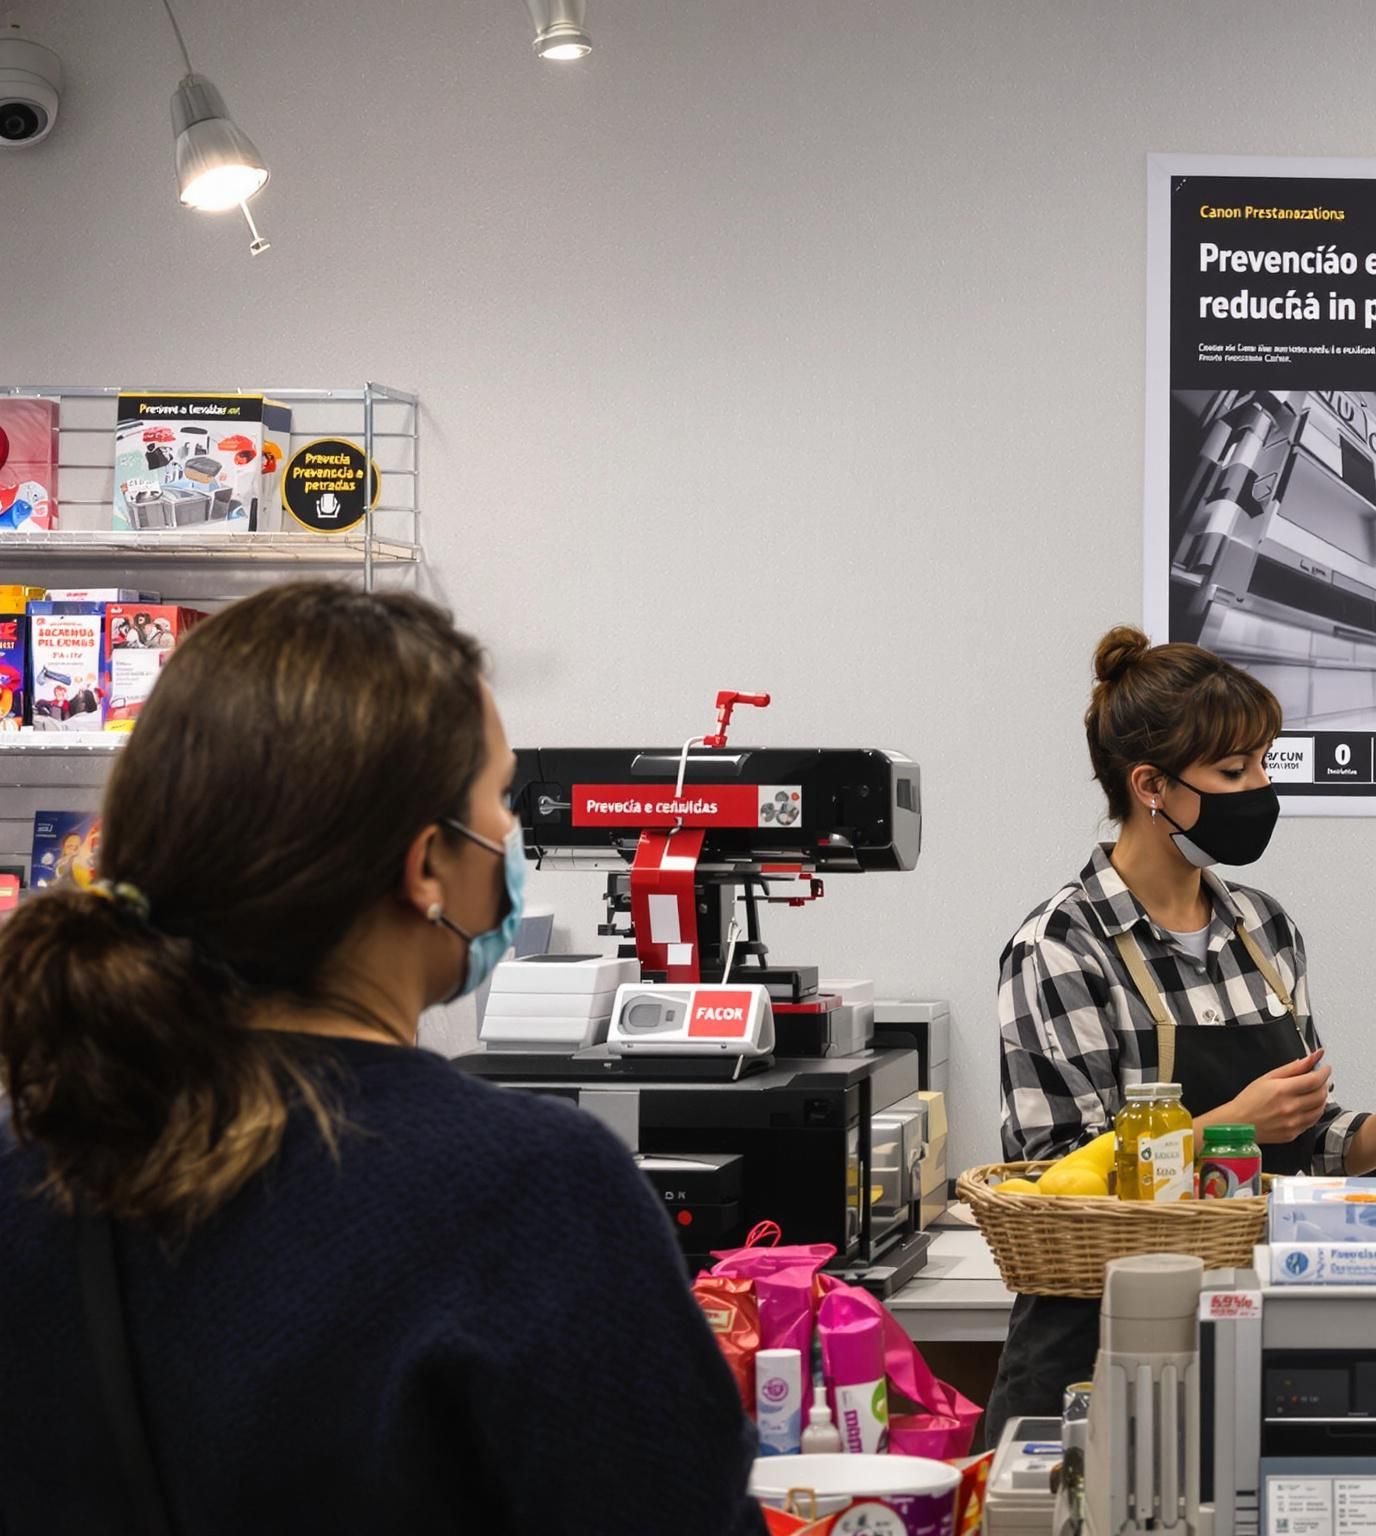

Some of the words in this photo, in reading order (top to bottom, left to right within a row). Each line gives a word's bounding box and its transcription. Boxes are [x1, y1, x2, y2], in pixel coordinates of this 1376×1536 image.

[1200, 205, 1241, 219] Canon
[1329, 291, 1356, 320] in
[644, 803, 652, 813] e
